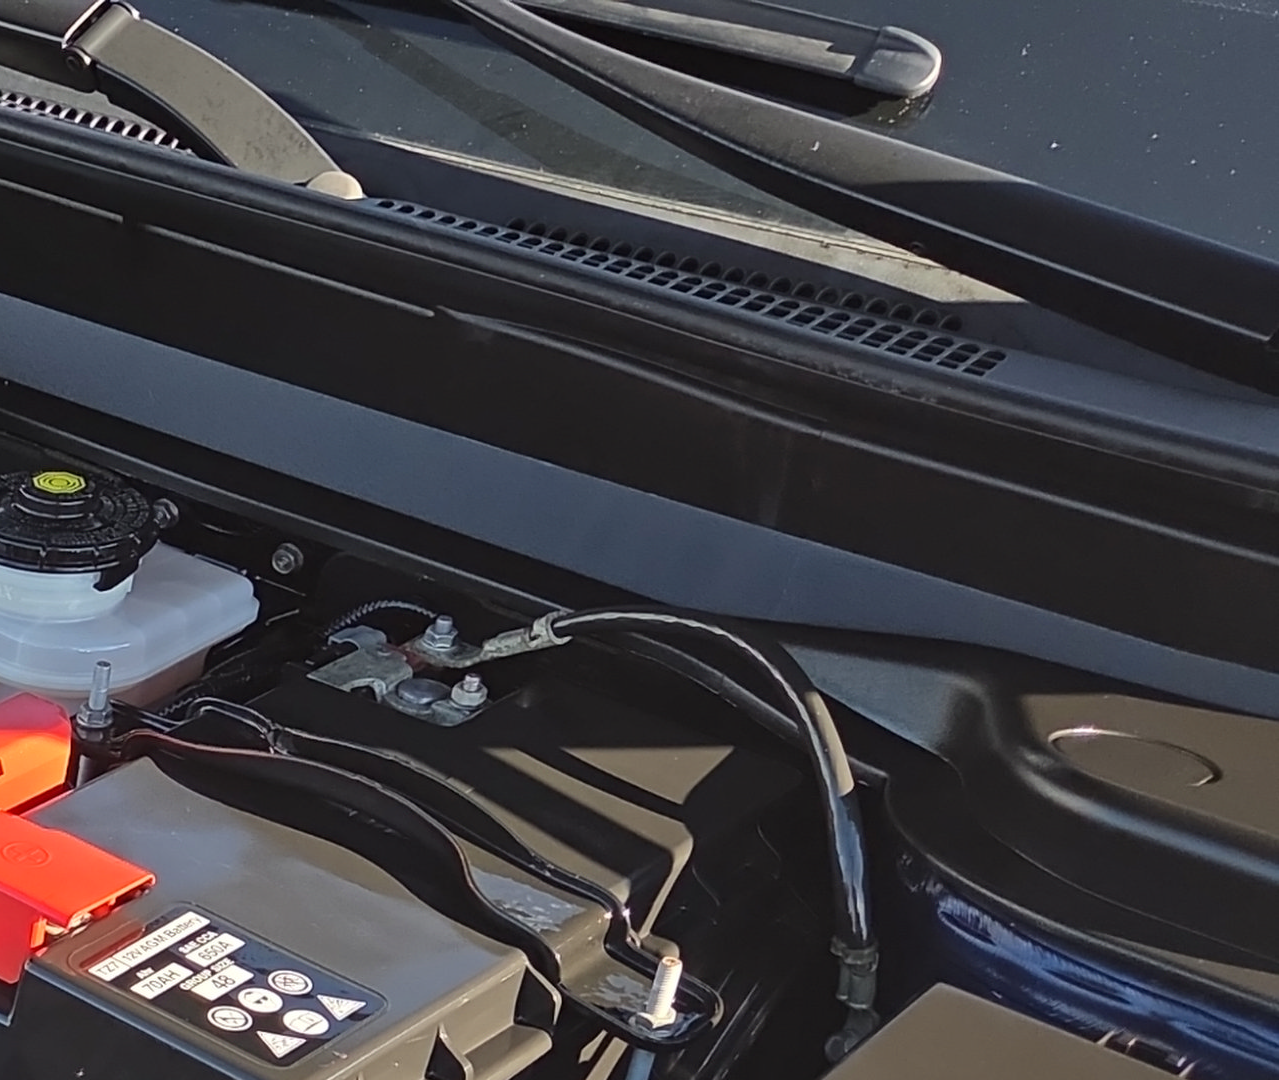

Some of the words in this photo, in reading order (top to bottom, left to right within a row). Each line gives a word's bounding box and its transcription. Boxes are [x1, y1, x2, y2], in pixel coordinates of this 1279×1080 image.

[96, 961, 119, 976] TZ7
[122, 947, 143, 961] 12V
[140, 935, 168, 952] AGM
[163, 916, 203, 938] Battery
[198, 940, 234, 960] 650A
[141, 969, 182, 992] 70AH
[180, 970, 211, 990] GROUP
[211, 958, 235, 972] SIZE
[211, 975, 236, 989] 48
